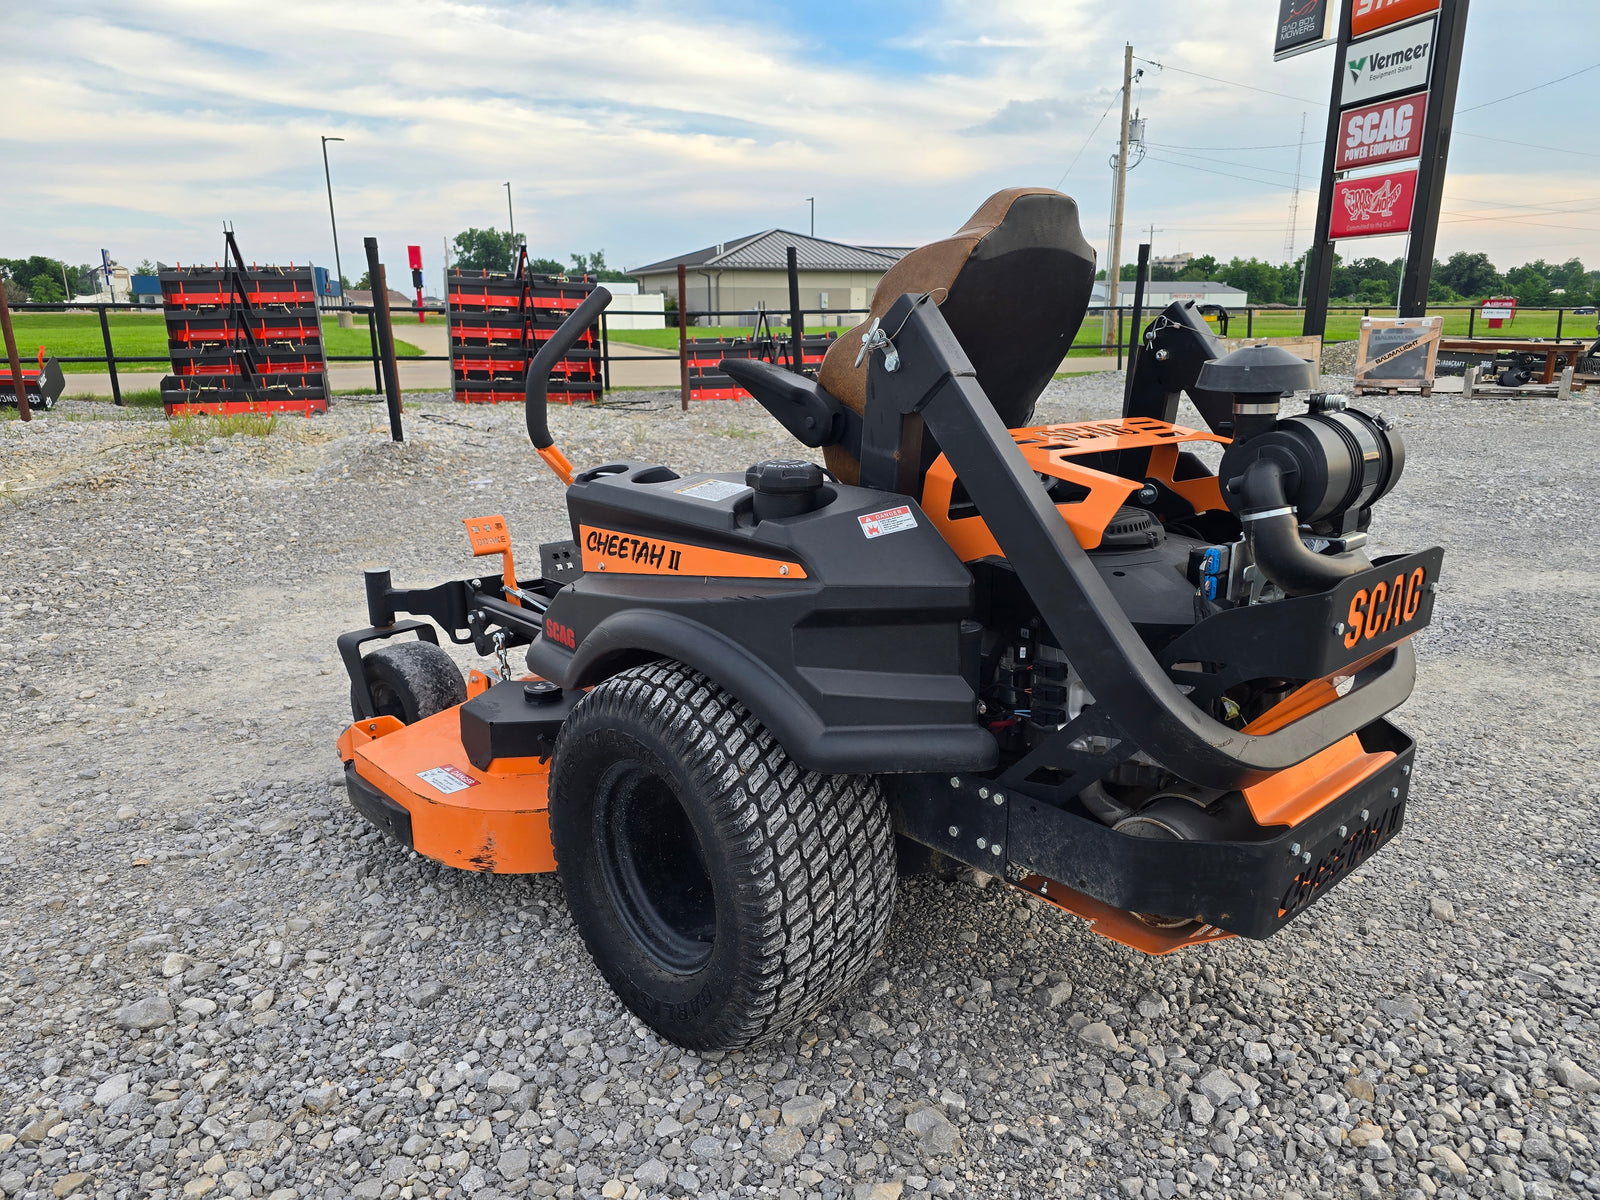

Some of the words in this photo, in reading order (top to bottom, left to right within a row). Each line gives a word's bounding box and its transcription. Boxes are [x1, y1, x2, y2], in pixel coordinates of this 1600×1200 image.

[1280, 23, 1315, 41] MOWERS
[1281, 22, 1298, 33] BAD
[1299, 15, 1316, 27] BOY
[1369, 42, 1430, 72] Vermeer
[1369, 68, 1397, 82] Equipment
[1397, 64, 1413, 75] Sales
[1346, 103, 1414, 148] SCAG
[1344, 145, 1369, 162] POWER
[1369, 137, 1410, 156] EQUIPMENT
[875, 509, 902, 520] DANGER
[476, 535, 507, 547] BRAKE
[586, 531, 666, 570] CHEETAH
[668, 549, 682, 571] II
[1343, 566, 1425, 650] SCAG
[546, 617, 576, 649] SCAG
[1277, 807, 1389, 918] CHEETAH
